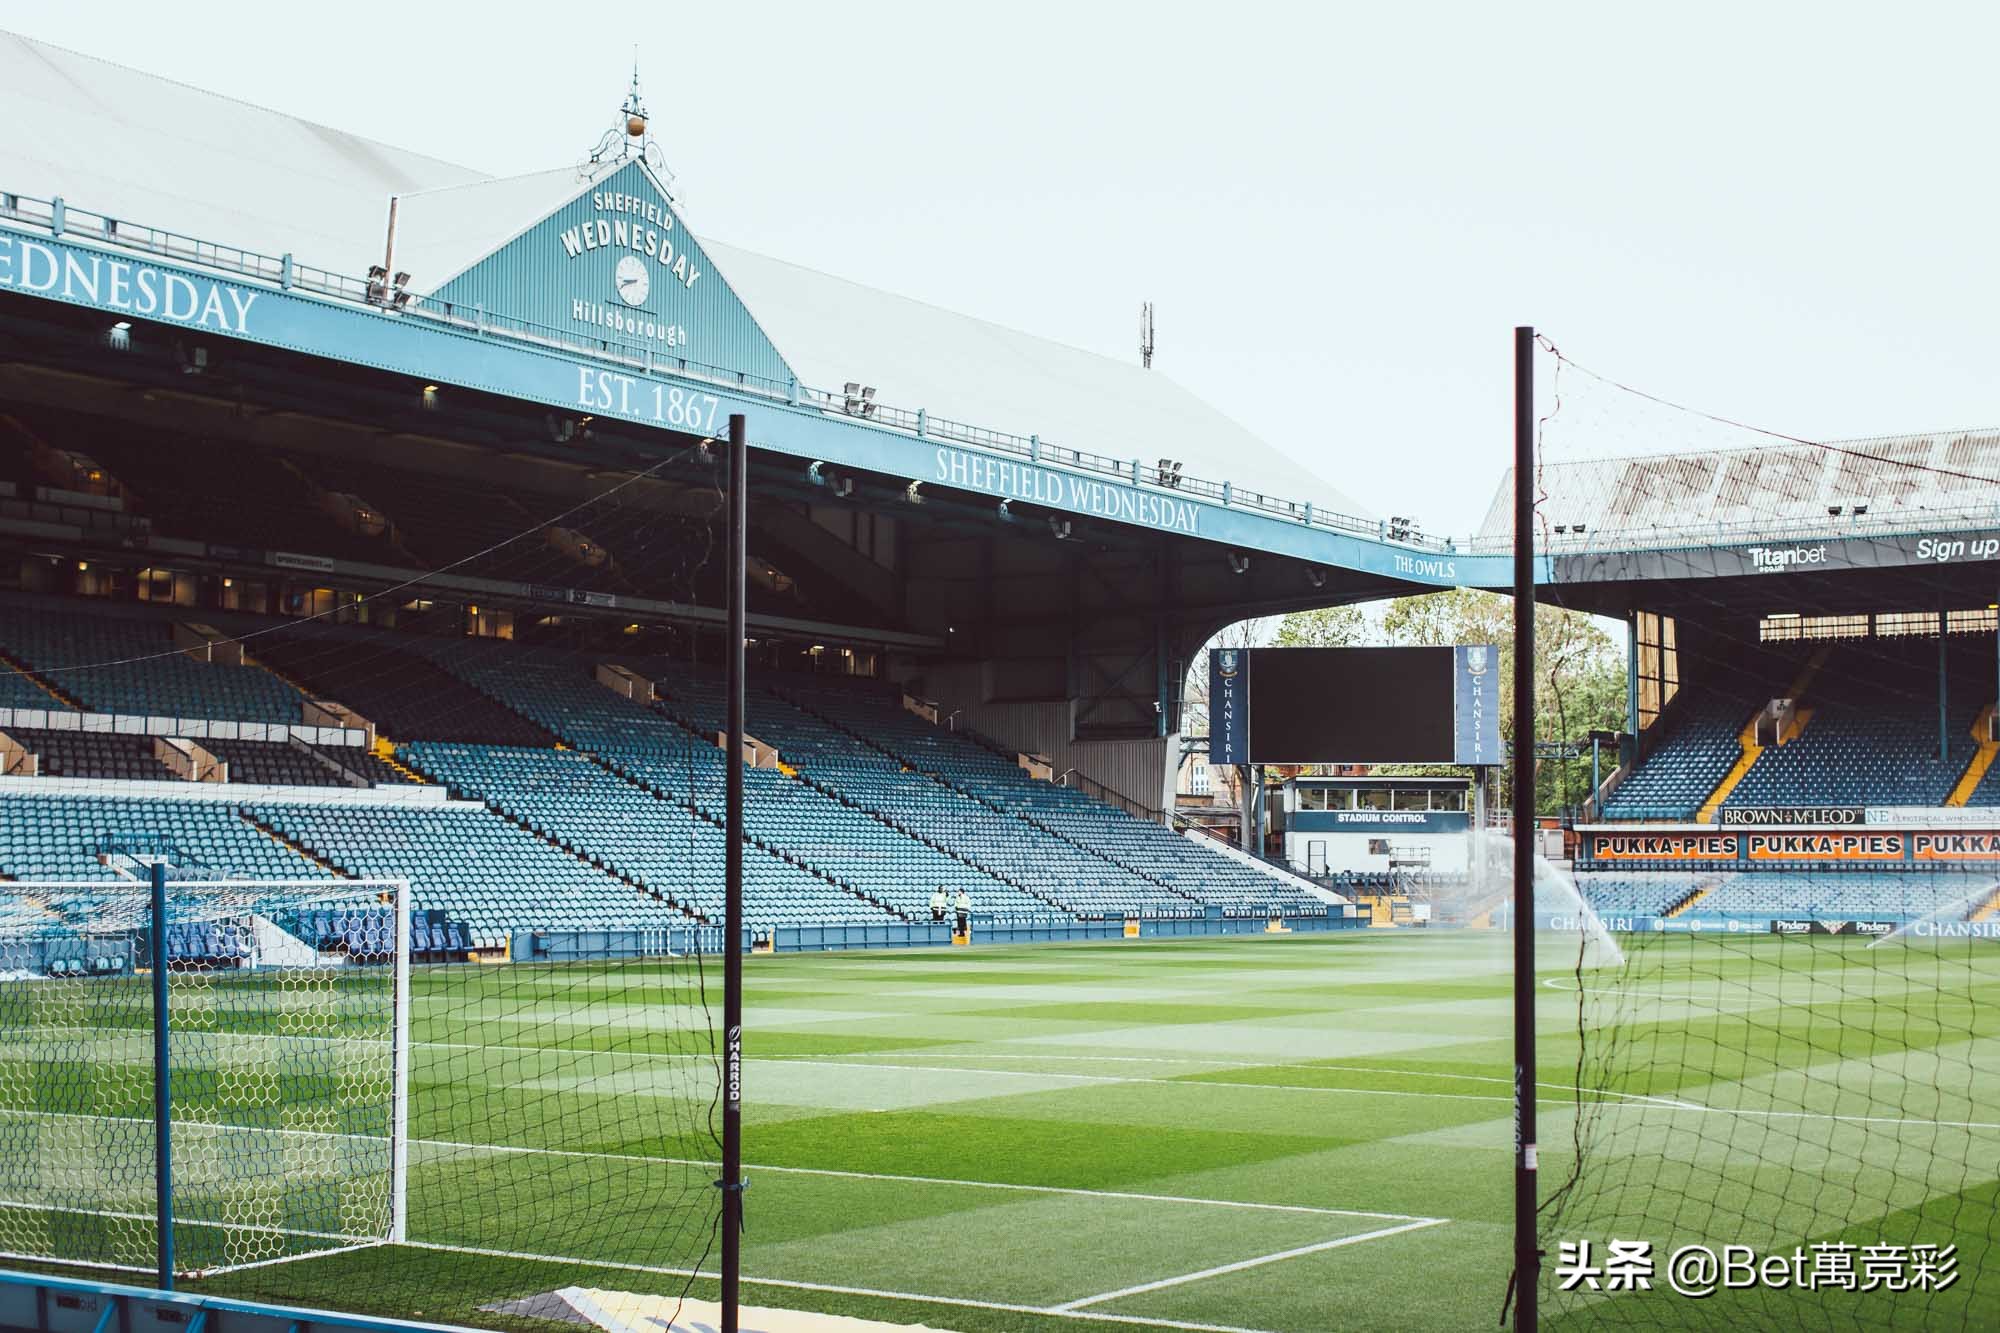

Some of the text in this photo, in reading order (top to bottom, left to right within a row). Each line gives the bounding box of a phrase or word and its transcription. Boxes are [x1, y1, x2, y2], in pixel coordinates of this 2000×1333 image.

[593, 192, 673, 231] SHEFFIELD
[560, 219, 701, 289] WEDNESDAY
[572, 298, 687, 347] Hillsborough
[577, 366, 720, 432] EST. 1867
[936, 448, 1200, 533] SHEFFIELD WEDNESDAY
[1747, 544, 1827, 567] Titanbet
[1916, 538, 2000, 562] Sign up
[1394, 554, 1456, 578] THE OWLS
[1224, 678, 1233, 764] CHANSIRI
[1473, 675, 1483, 764] CHANSIRI
[1338, 813, 1427, 823] STADIUM CONTROL
[1724, 809, 1783, 824] BROWN
[1597, 836, 1738, 855] PUKKA-PIES
[1750, 834, 1902, 854] PUKKA-PIES
[1776, 920, 1811, 931] Pinders
[1855, 921, 1891, 932] Pinders
[729, 1041, 741, 1101] HARROD
